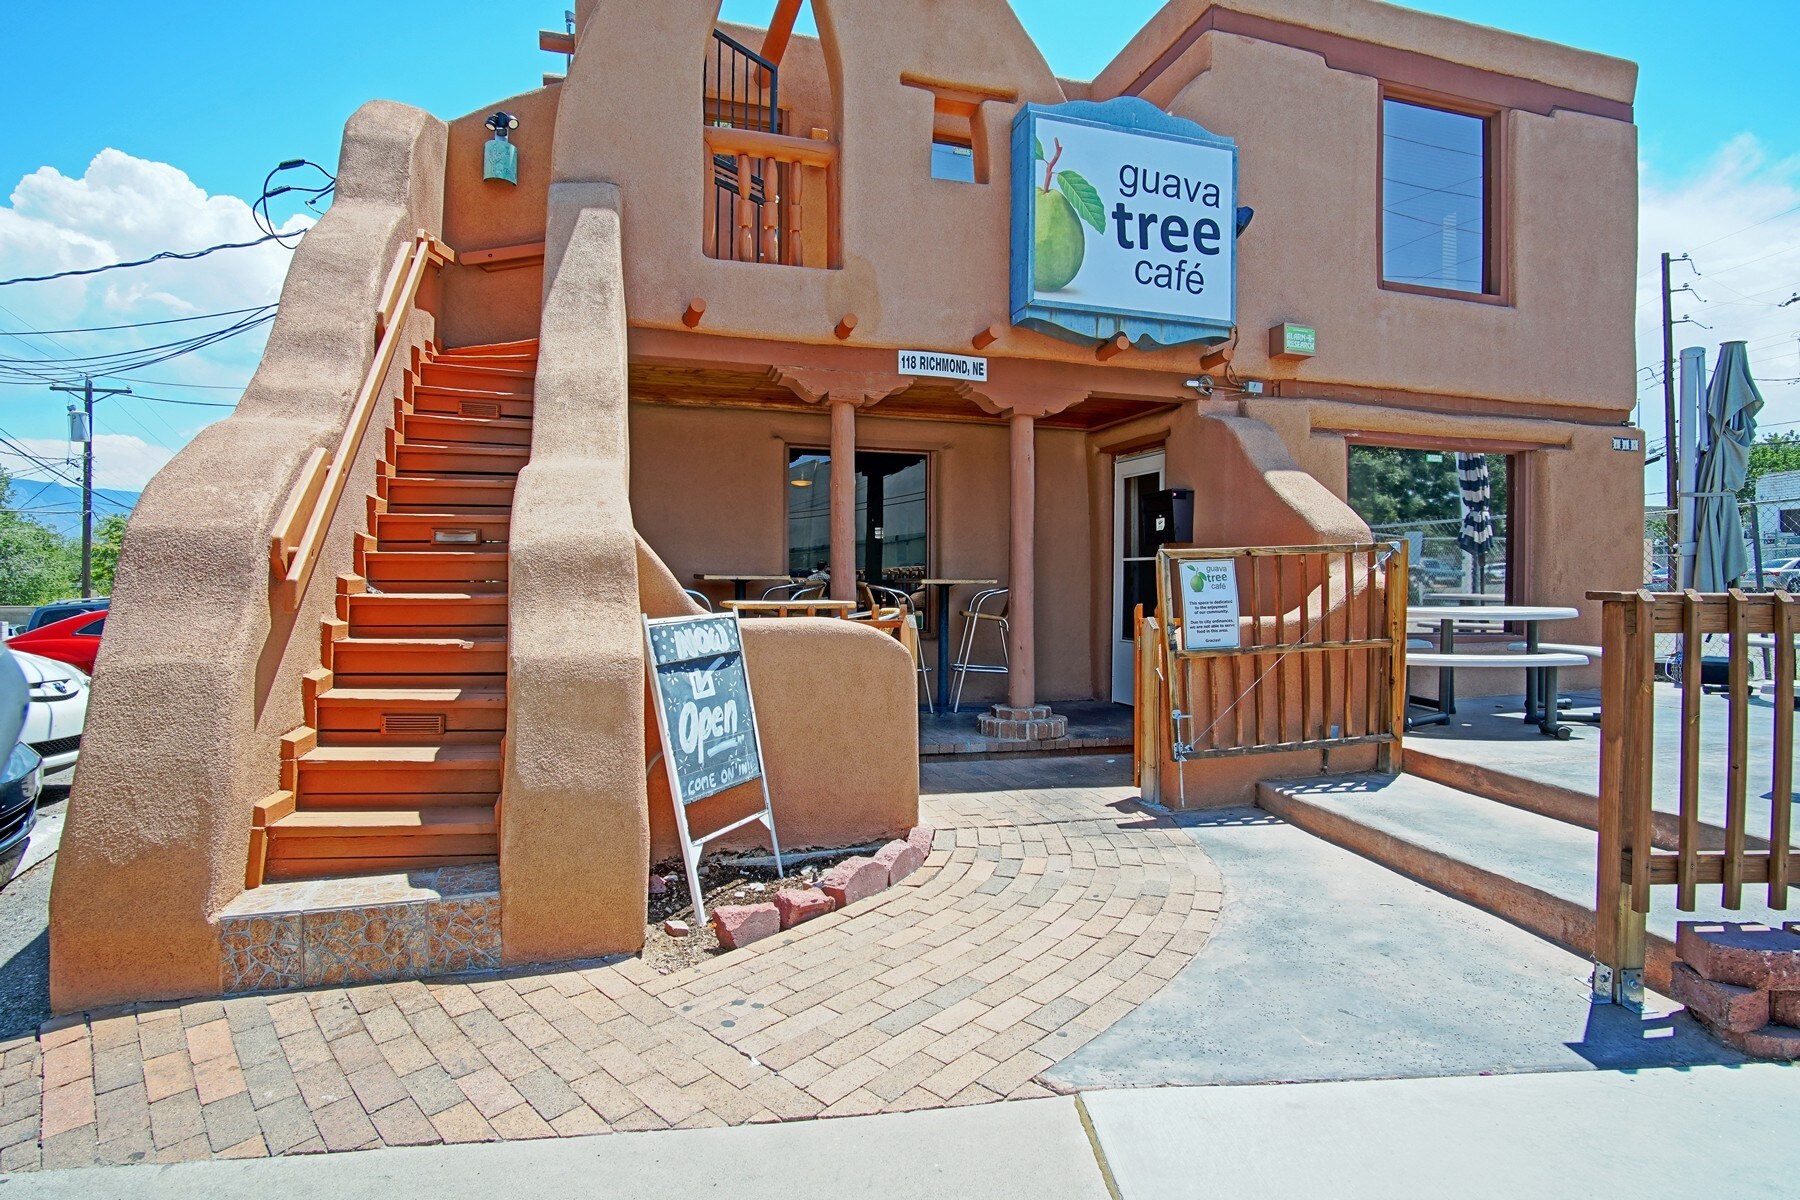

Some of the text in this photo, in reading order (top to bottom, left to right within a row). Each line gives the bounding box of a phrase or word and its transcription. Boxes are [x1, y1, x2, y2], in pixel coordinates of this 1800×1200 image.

[1119, 164, 1220, 208] guava
[1111, 202, 1221, 255] tree
[1135, 259, 1204, 295] café
[901, 355, 985, 376] 118 RICHMOND, NE
[1207, 574, 1227, 582] tree
[673, 624, 730, 659] NOW
[678, 699, 738, 765] Open
[687, 773, 717, 796] COME
[720, 766, 735, 784] ON
